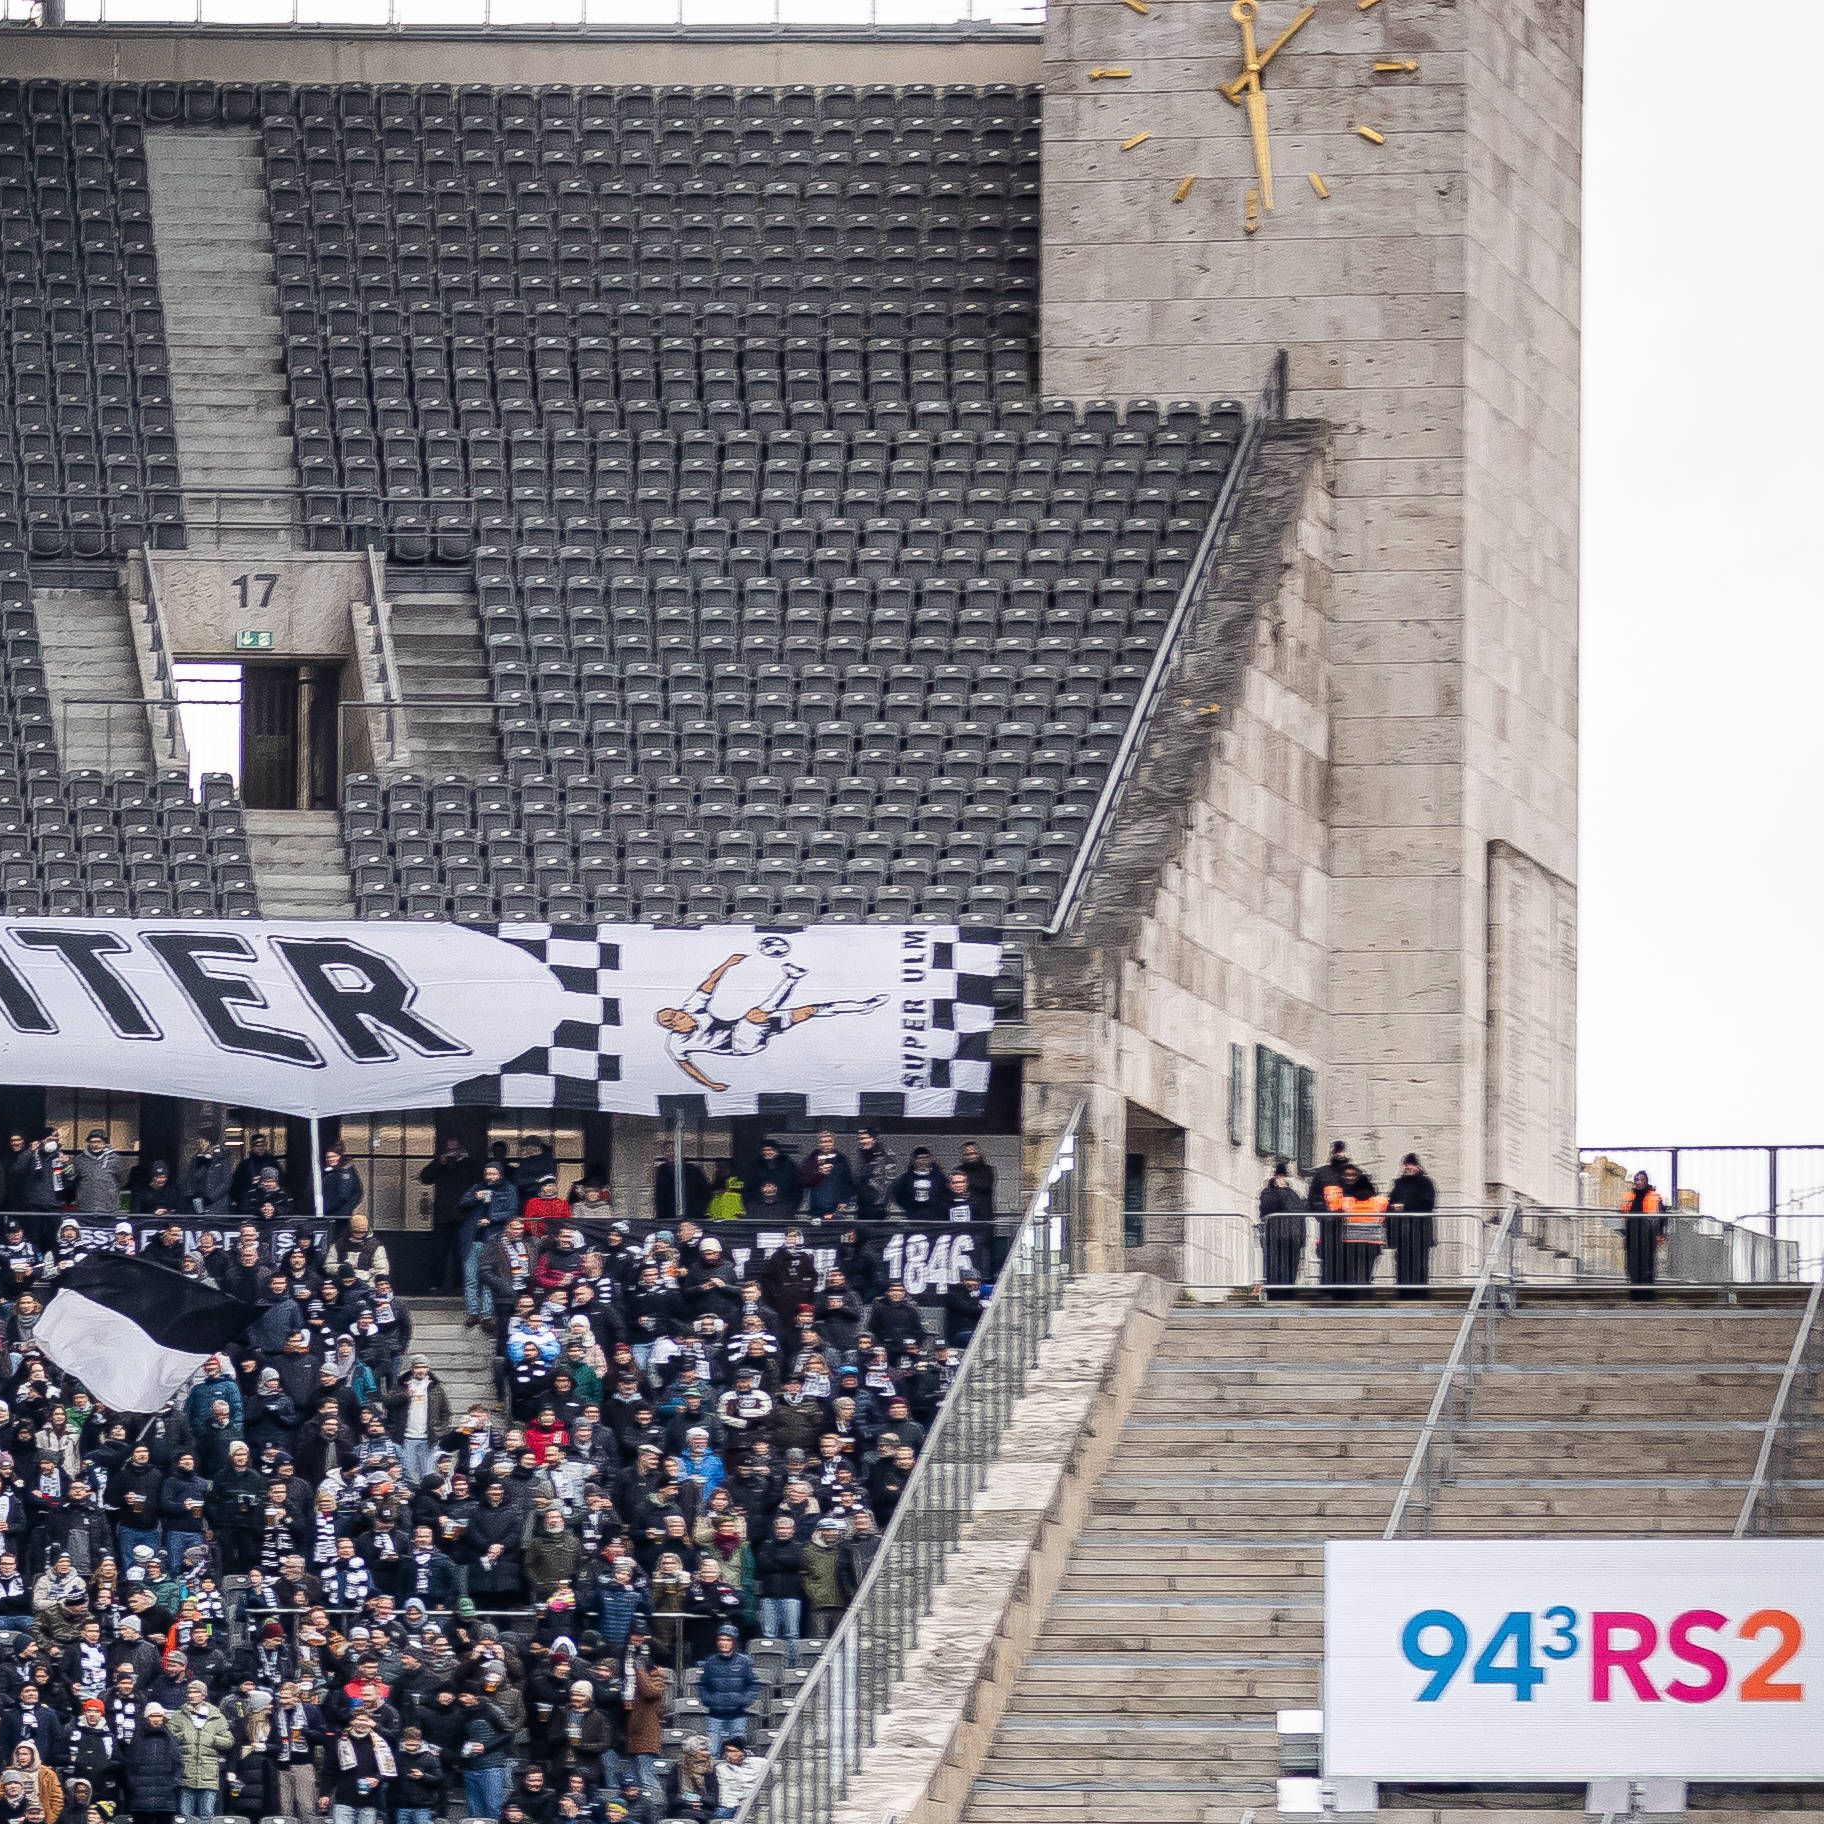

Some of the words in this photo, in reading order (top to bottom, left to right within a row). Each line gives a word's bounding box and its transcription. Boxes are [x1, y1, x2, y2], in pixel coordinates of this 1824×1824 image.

[231, 573, 281, 608] 17
[903, 930, 927, 982] ULM
[903, 1000, 926, 1088] SUPER
[883, 1233, 976, 1295] 1846
